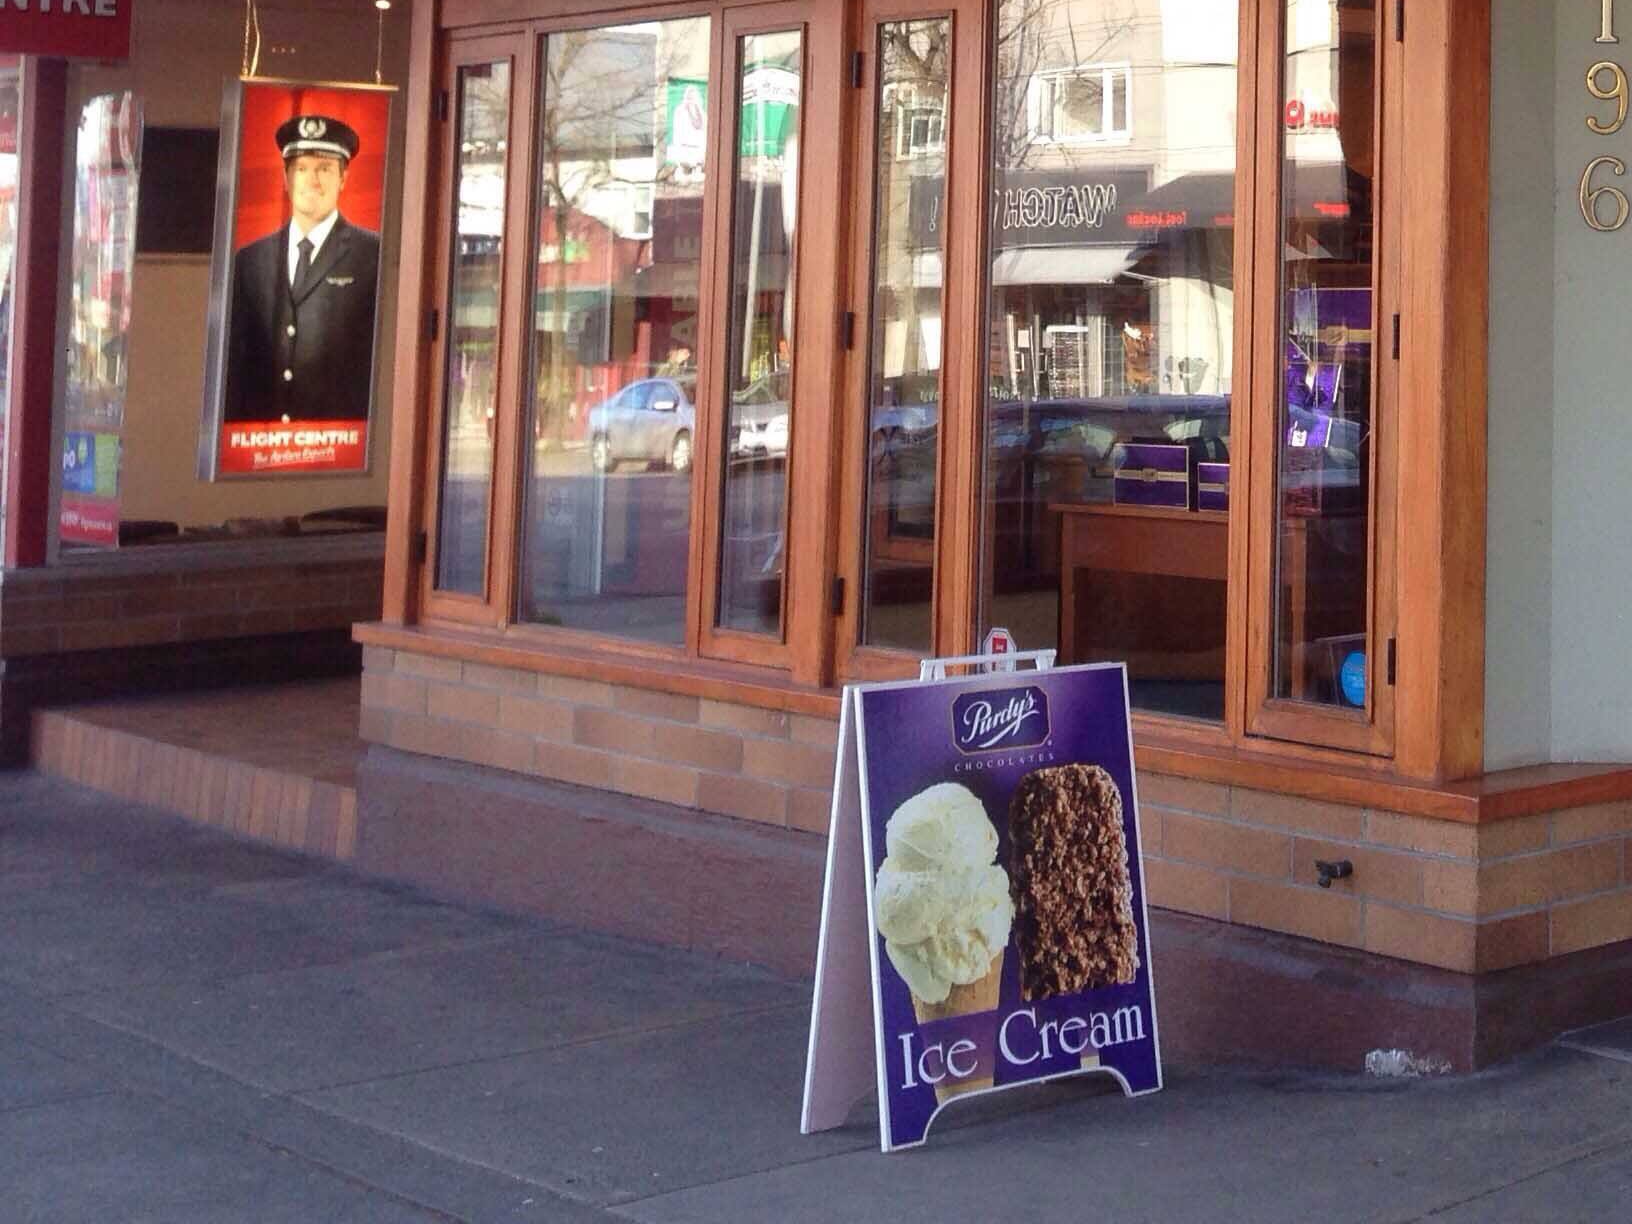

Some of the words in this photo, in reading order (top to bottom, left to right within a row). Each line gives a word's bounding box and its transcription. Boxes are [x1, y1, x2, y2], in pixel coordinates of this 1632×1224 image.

[231, 432, 291, 448] FLIGHT
[294, 429, 359, 446] CENTRE
[961, 689, 1041, 749] Purdy's
[954, 752, 1055, 773] CHOCOLATES
[898, 1032, 978, 1090] Ice
[999, 1004, 1147, 1066] Cream
